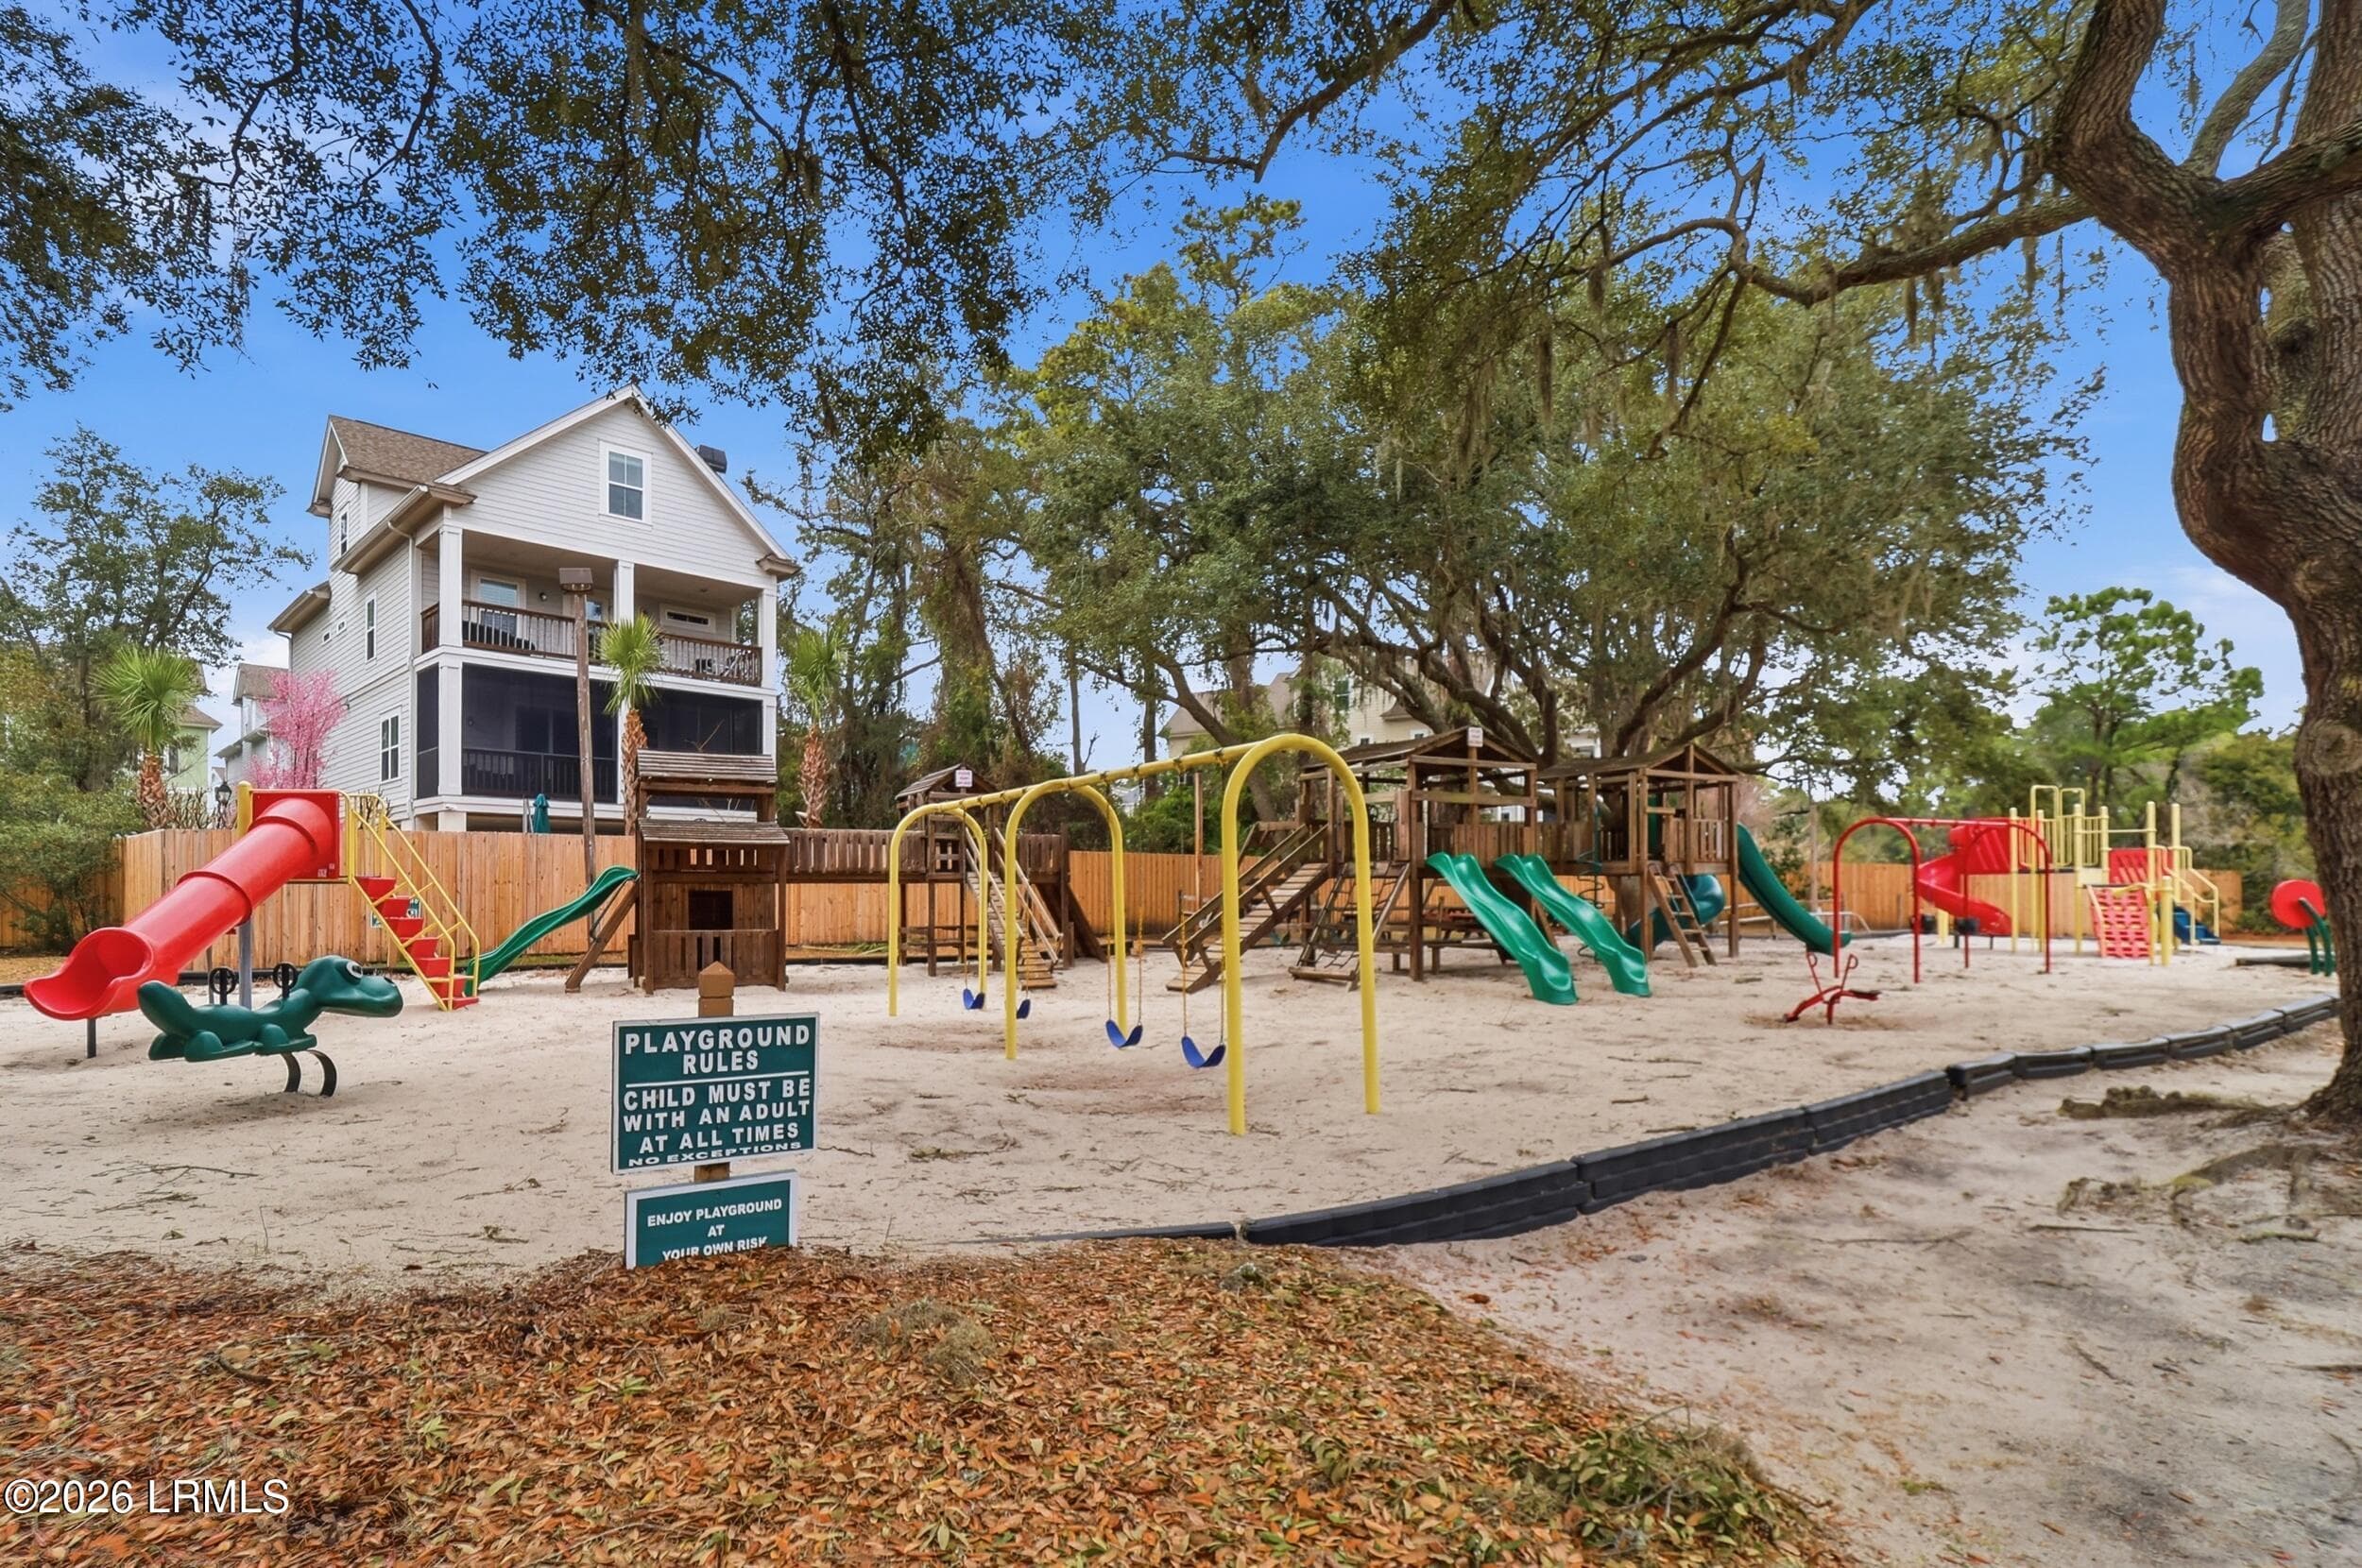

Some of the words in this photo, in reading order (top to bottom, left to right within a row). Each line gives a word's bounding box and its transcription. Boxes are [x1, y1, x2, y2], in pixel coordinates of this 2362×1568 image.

[625, 1025, 810, 1055] PLAYGROUND
[683, 1049, 759, 1075] RULES
[624, 1086, 695, 1111] CHILD
[709, 1081, 771, 1104] MUST
[782, 1078, 811, 1099] BE
[624, 1110, 686, 1133] WITH
[698, 1106, 730, 1125] AN
[739, 1099, 810, 1122] ADULT
[639, 1134, 668, 1154] AT
[678, 1130, 723, 1150] ALL
[731, 1122, 799, 1144] TIMES
[628, 1156, 659, 1167] NO
[667, 1141, 802, 1164] EXCEPTIONS
[647, 1210, 693, 1227] ENJOY
[695, 1198, 782, 1221] PLAYGROUND
[708, 1224, 725, 1237] AT
[662, 1246, 699, 1262] YOUR
[703, 1241, 734, 1256] OWN
[737, 1236, 768, 1252] RISK
